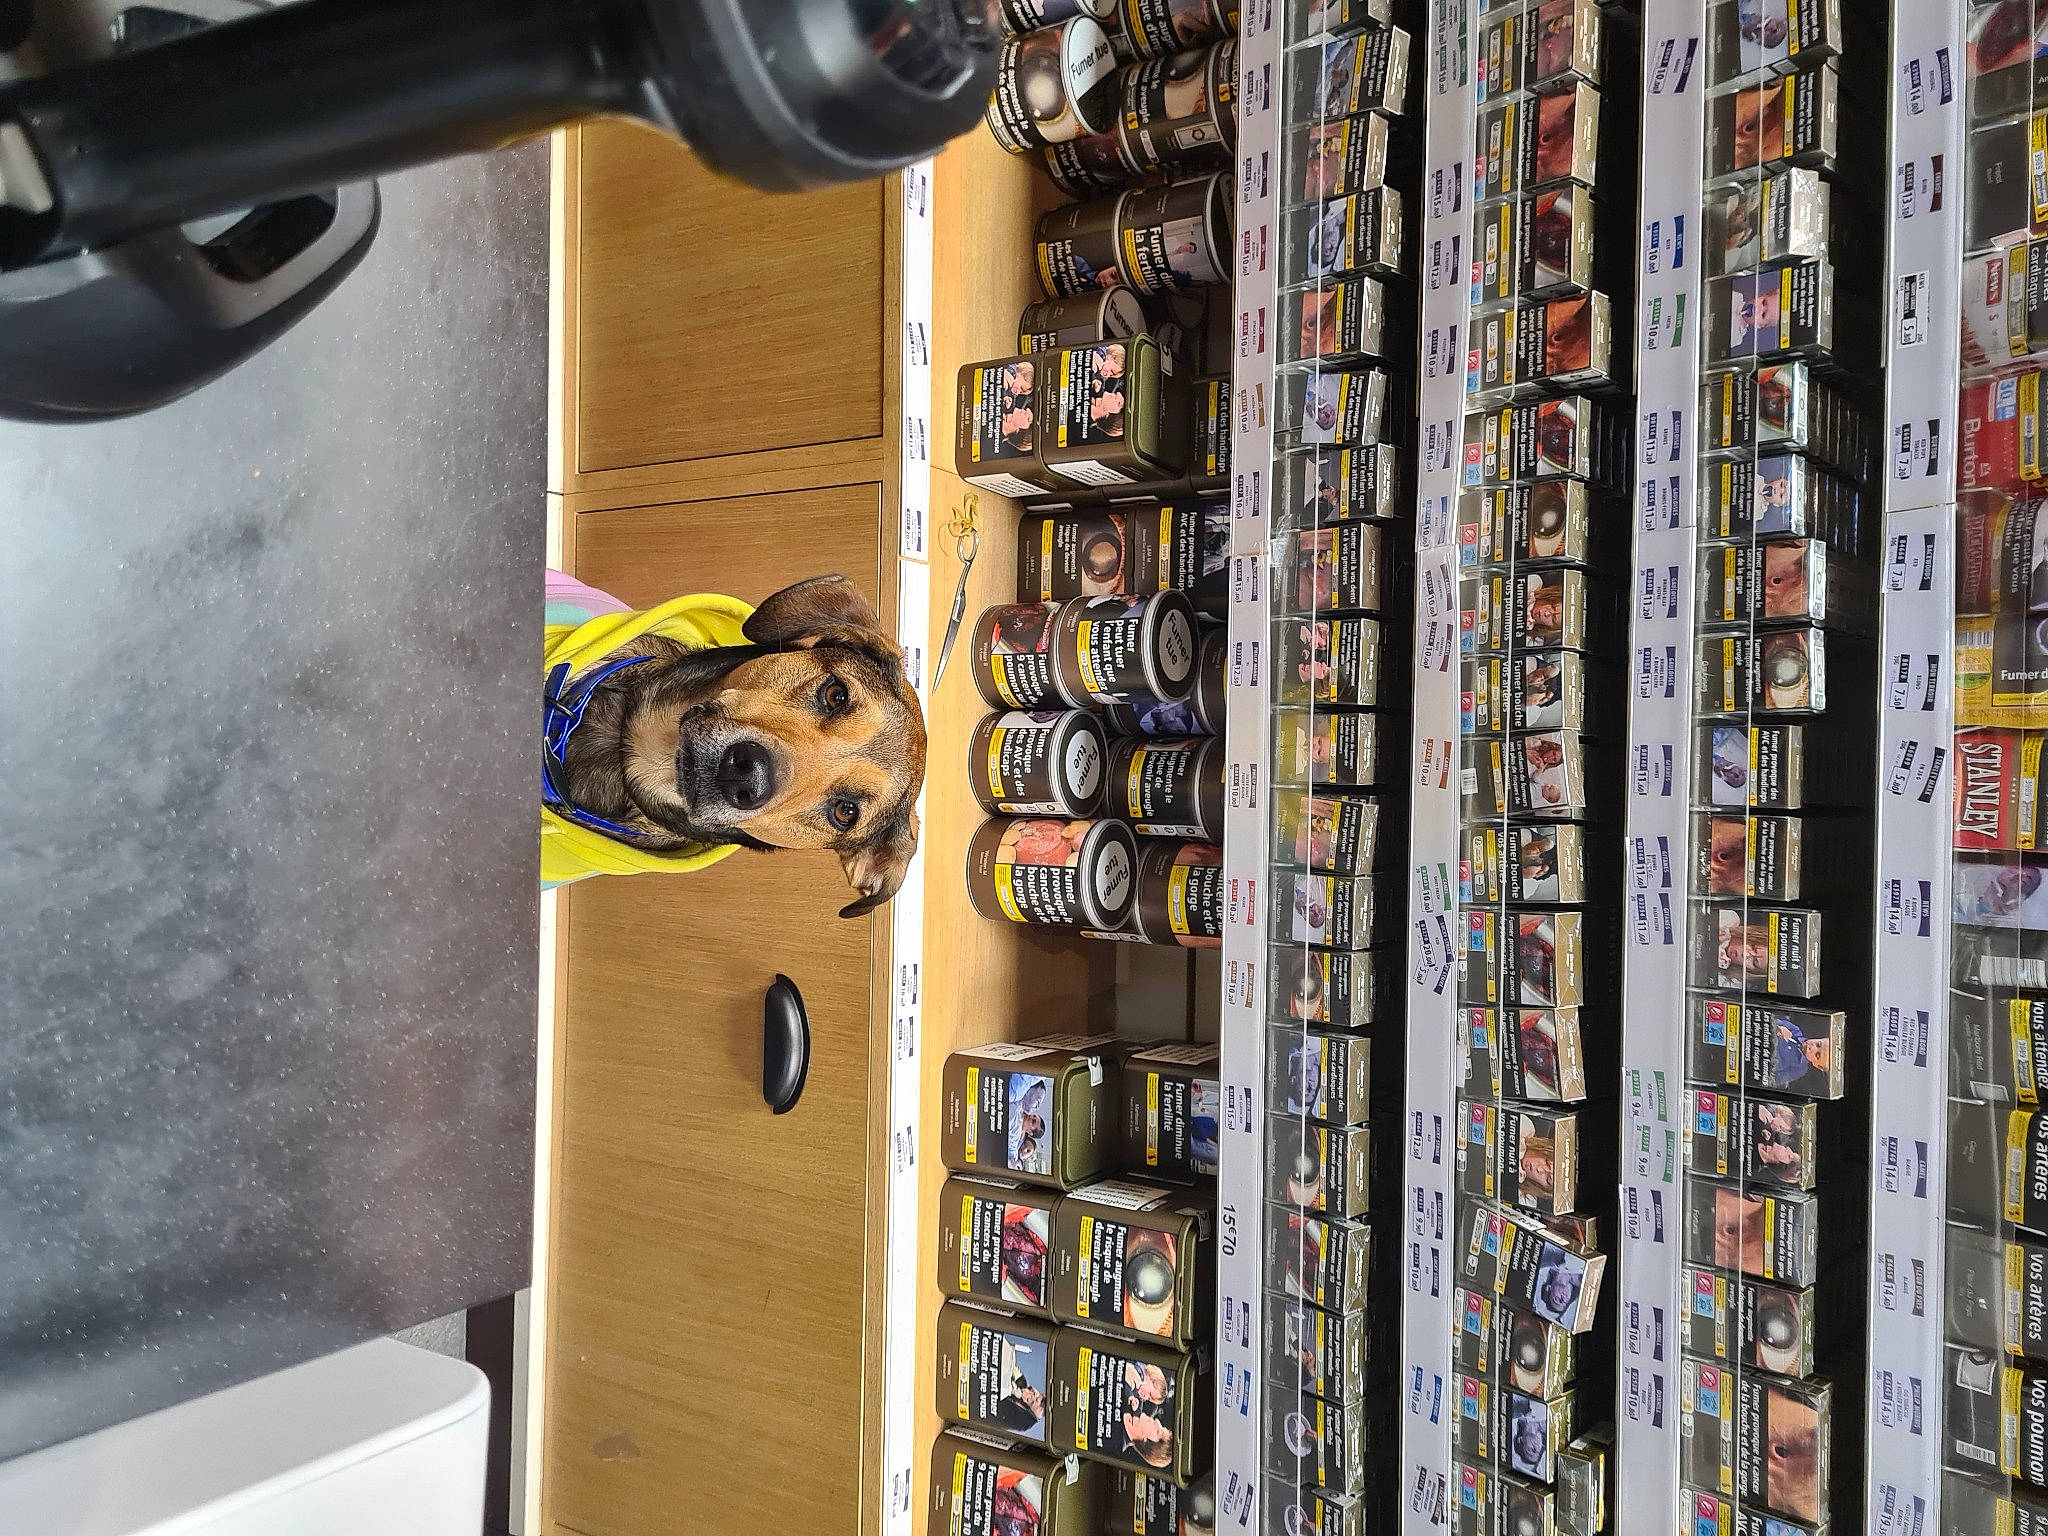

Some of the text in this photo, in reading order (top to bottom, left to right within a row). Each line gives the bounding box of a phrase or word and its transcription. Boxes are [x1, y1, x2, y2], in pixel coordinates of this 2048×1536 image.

[1134, 228, 1161, 289] la fertilité
[1149, 226, 1165, 269] Fumer
[2028, 247, 2042, 311] cardiaques
[1365, 448, 1376, 490] Fumer peut
[1645, 440, 1655, 461] 11.20
[1898, 460, 1909, 477] 7.20
[1963, 418, 1982, 487] Burton
[1350, 470, 1359, 501] attendez
[1176, 513, 1188, 592] AVC et des handicaps
[1186, 512, 1197, 588] Fumer provoque des
[1754, 548, 1763, 568] Fumer
[1515, 578, 1525, 605] Fumer
[1753, 569, 1763, 600] provoque
[1892, 571, 1903, 588] 7.30
[1515, 607, 1525, 628] nuit
[1643, 596, 1653, 617] 11.20
[1090, 620, 1108, 691] vous attendez
[1102, 620, 1117, 683] l'enfant que
[1113, 619, 1126, 669] peut tuer
[1126, 618, 1139, 653] Fumer
[1165, 637, 1178, 666] tue
[1167, 611, 1191, 663] Fumer
[1004, 654, 1018, 693] poumon
[1016, 663, 1032, 696] cancers
[1025, 654, 1045, 697] provoque
[1038, 653, 1050, 685] Fumer
[1640, 674, 1650, 696] 11.20
[1752, 639, 1762, 694] Fumer augmente
[1513, 660, 1524, 727] Fumer bouche
[1001, 728, 1016, 777] handicaps
[1022, 728, 1037, 774] provoque
[1035, 728, 1049, 759] Fumer
[1073, 744, 1088, 769] tue
[1761, 730, 1770, 745] AVC
[1013, 728, 1028, 797] des AVC et des
[1076, 745, 1099, 794] Fumer
[1154, 751, 1168, 789] risque de
[1163, 751, 1179, 804] augmente le
[1177, 751, 1191, 777] Fumer
[1761, 755, 1769, 768] des
[1768, 730, 1779, 801] Fumer provoque des
[1142, 751, 1159, 817] devenir aveugle
[1758, 768, 1769, 803] handicaps
[1955, 742, 2002, 839] STANLEY
[1039, 867, 1052, 904] cancer
[1064, 868, 1076, 904] Fumer
[1102, 864, 1129, 902] Fumer
[1104, 855, 1119, 876] tue
[1509, 831, 1519, 899] Fumer bouche
[1012, 866, 1029, 909] la gorge
[1027, 866, 1041, 906] bouche
[1035, 907, 1045, 916] et
[1049, 868, 1068, 917] provoque
[1044, 904, 1056, 915] de
[1791, 918, 1801, 943] Fumer
[1887, 909, 1898, 932] 14.00
[1778, 917, 1789, 971] vos poumons
[1791, 944, 1801, 961] nuit
[1163, 1081, 1174, 1132] la fertilité
[1174, 1082, 1185, 1160] Fumer diminue
[971, 1200, 982, 1273] poumon sur 10
[982, 1210, 991, 1247] cancers
[990, 1203, 1004, 1284] Fumer provoque
[1221, 1203, 1237, 1257] 15€70
[982, 1249, 992, 1263] du
[1088, 1221, 1104, 1303] devenir aveugle
[1102, 1223, 1116, 1284] le risque de
[1111, 1226, 1127, 1313] Fumer augmente
[2028, 1254, 2046, 1340] vos artères
[970, 1327, 979, 1374] attendez
[978, 1330, 991, 1419] l'enfant que vous
[989, 1333, 1001, 1417] Fumer peut tuer
[2031, 1379, 2047, 1406] vos
[1750, 1383, 1762, 1495] Fumer provoque le cancer
